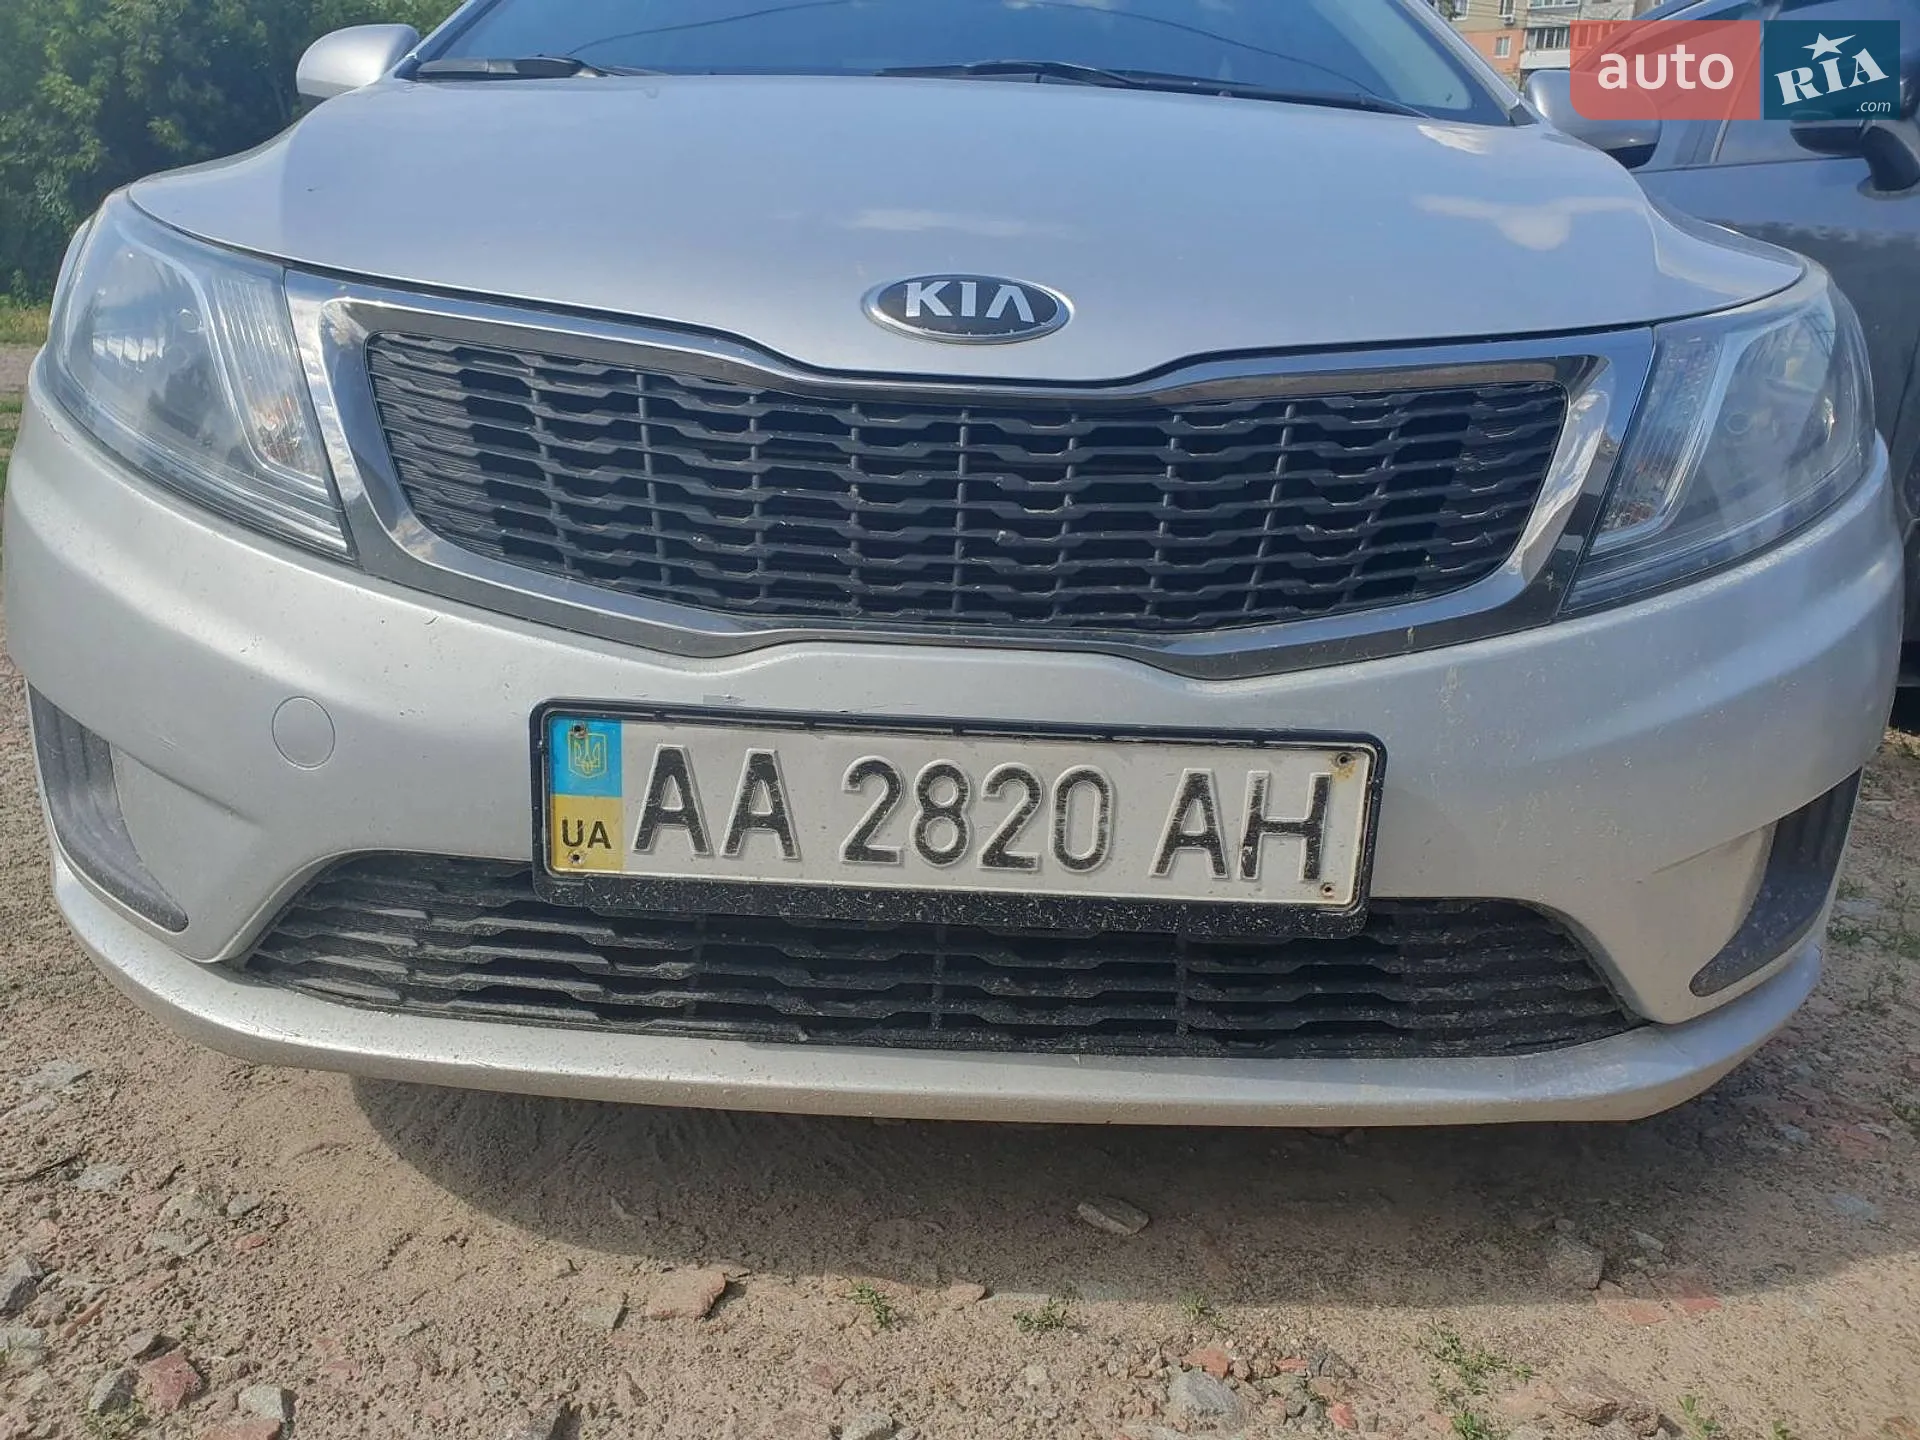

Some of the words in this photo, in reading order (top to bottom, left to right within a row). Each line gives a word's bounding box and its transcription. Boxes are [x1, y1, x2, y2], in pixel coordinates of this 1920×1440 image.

[904, 281, 1035, 323] KIA
[632, 744, 801, 862] AA
[840, 755, 1114, 873] 2820
[1149, 767, 1333, 882] AH
[561, 819, 612, 850] UA
